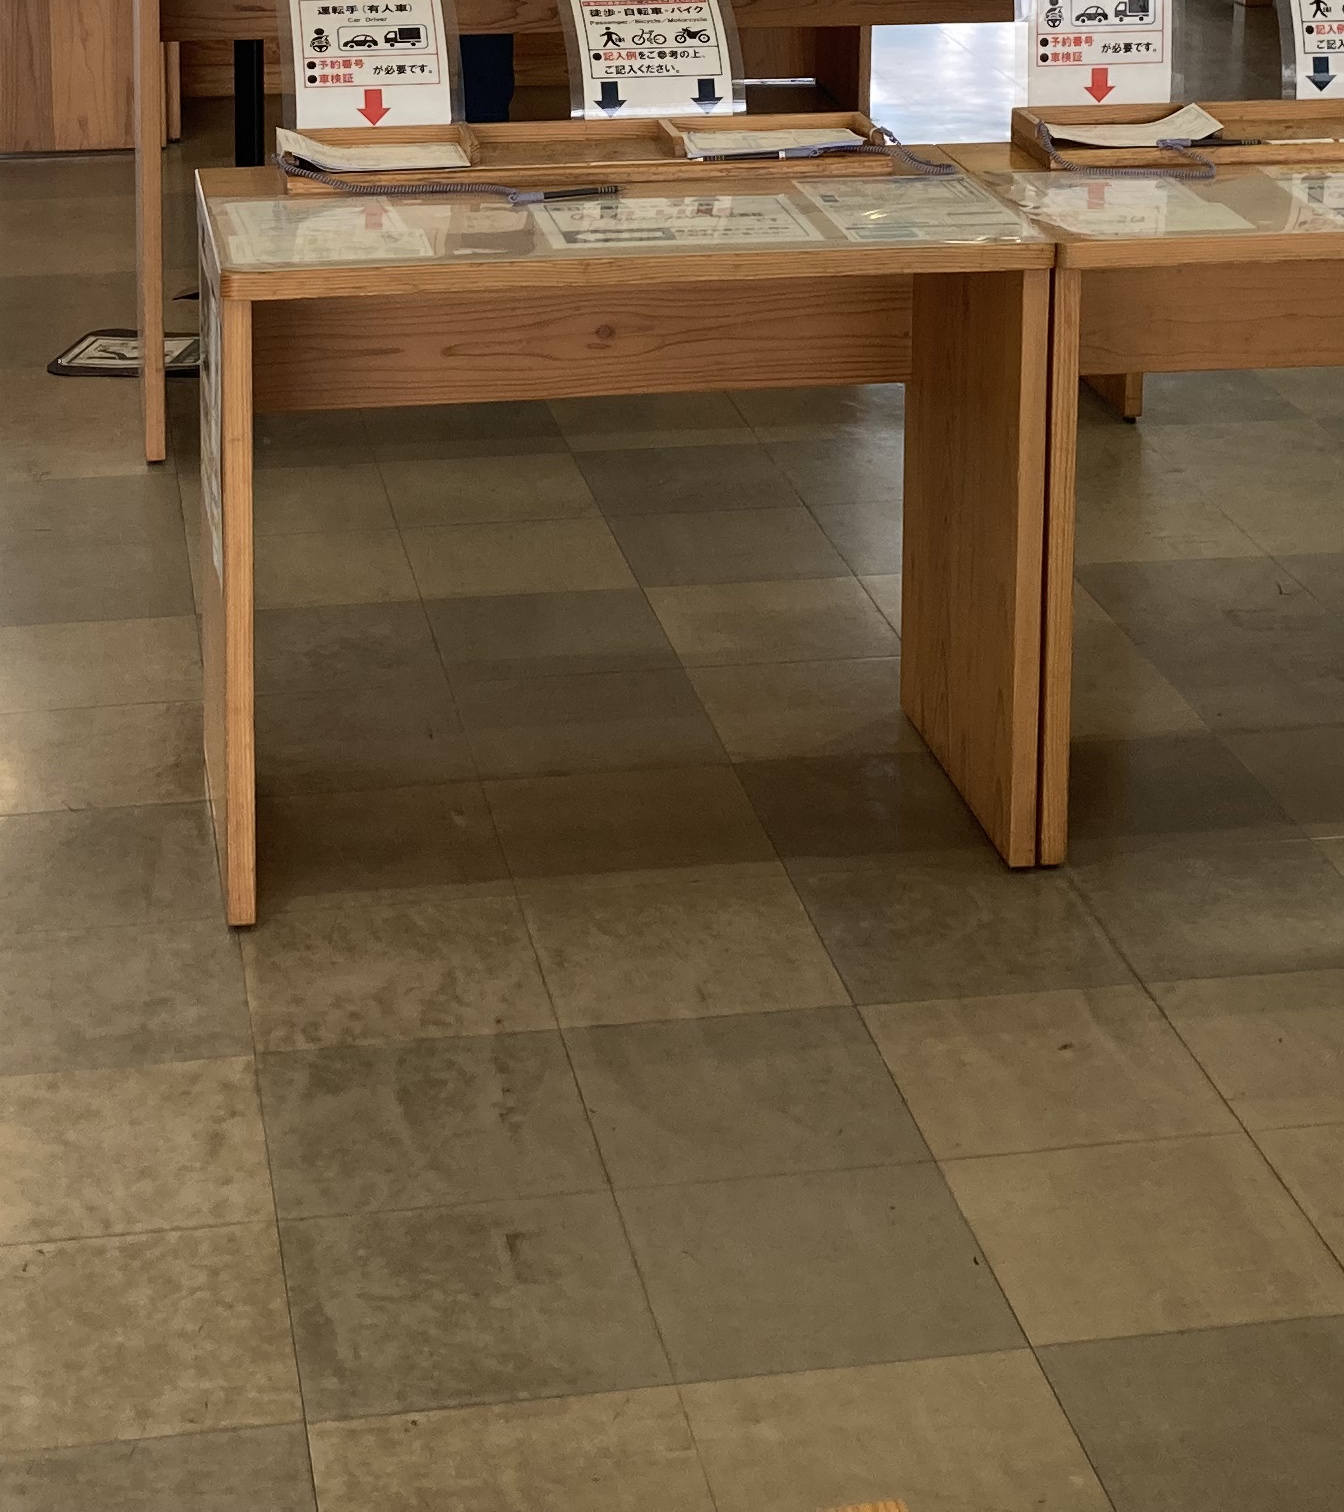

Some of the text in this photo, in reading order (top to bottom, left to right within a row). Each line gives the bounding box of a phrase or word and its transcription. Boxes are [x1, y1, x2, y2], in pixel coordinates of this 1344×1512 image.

[589, 5, 704, 18] 徒歩・自転車・バイク
[1050, 35, 1095, 47] 予約番号
[604, 64, 680, 76] ご記入ください。
